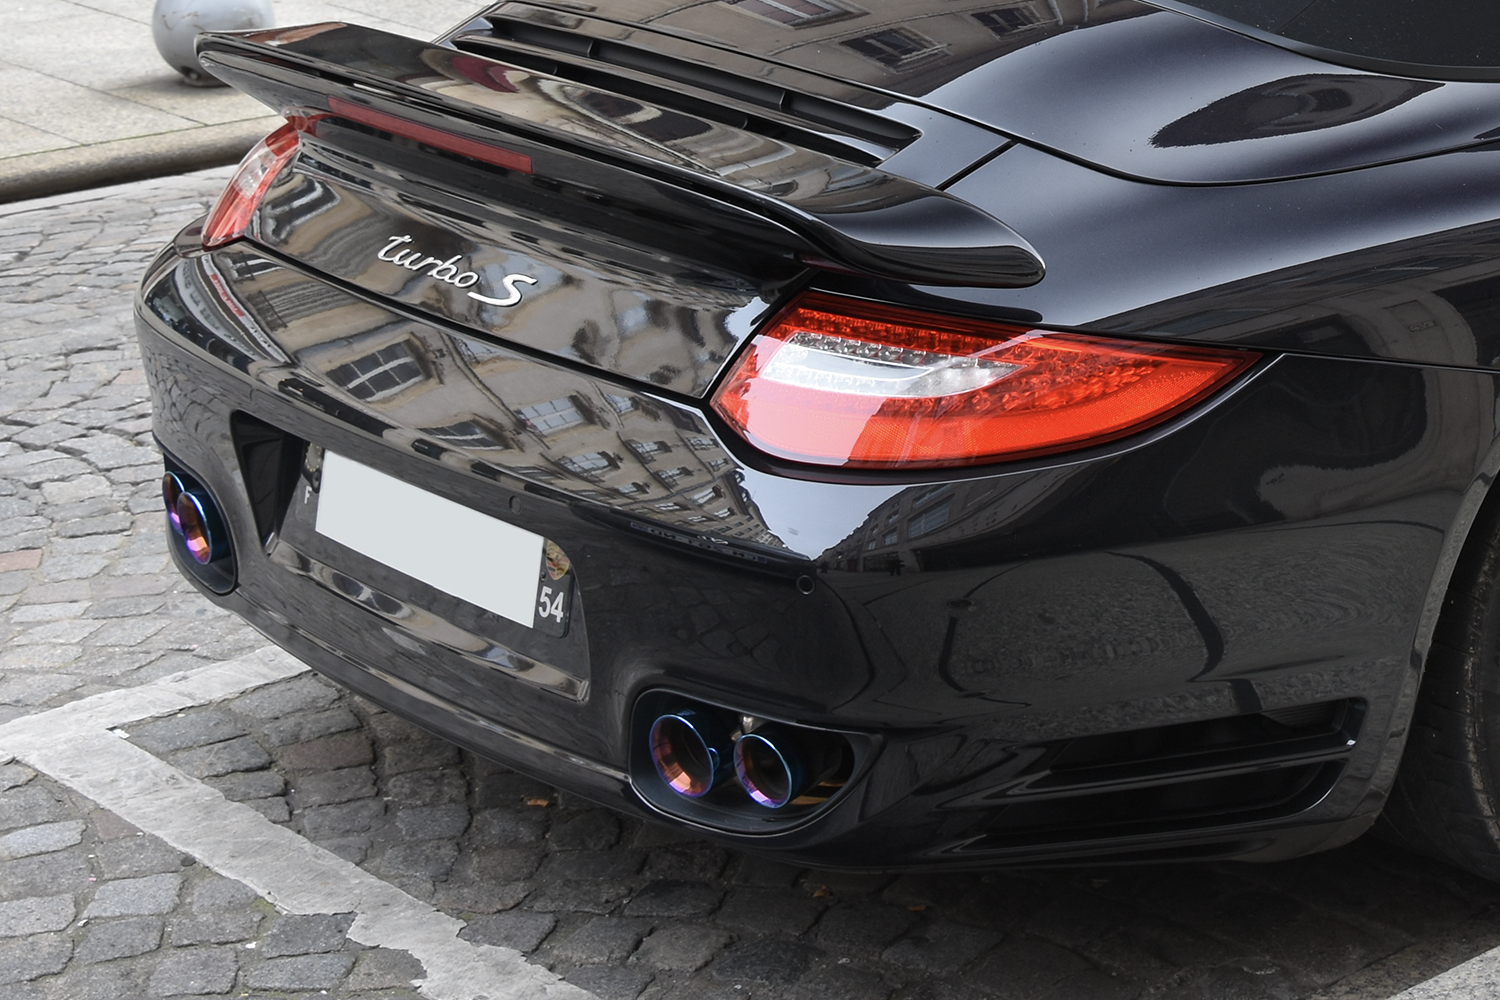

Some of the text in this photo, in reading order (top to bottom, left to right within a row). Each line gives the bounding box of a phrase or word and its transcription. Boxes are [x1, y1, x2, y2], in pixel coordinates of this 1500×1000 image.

[378, 234, 538, 307] turbo S
[304, 485, 313, 504] F
[538, 585, 564, 623] 54
